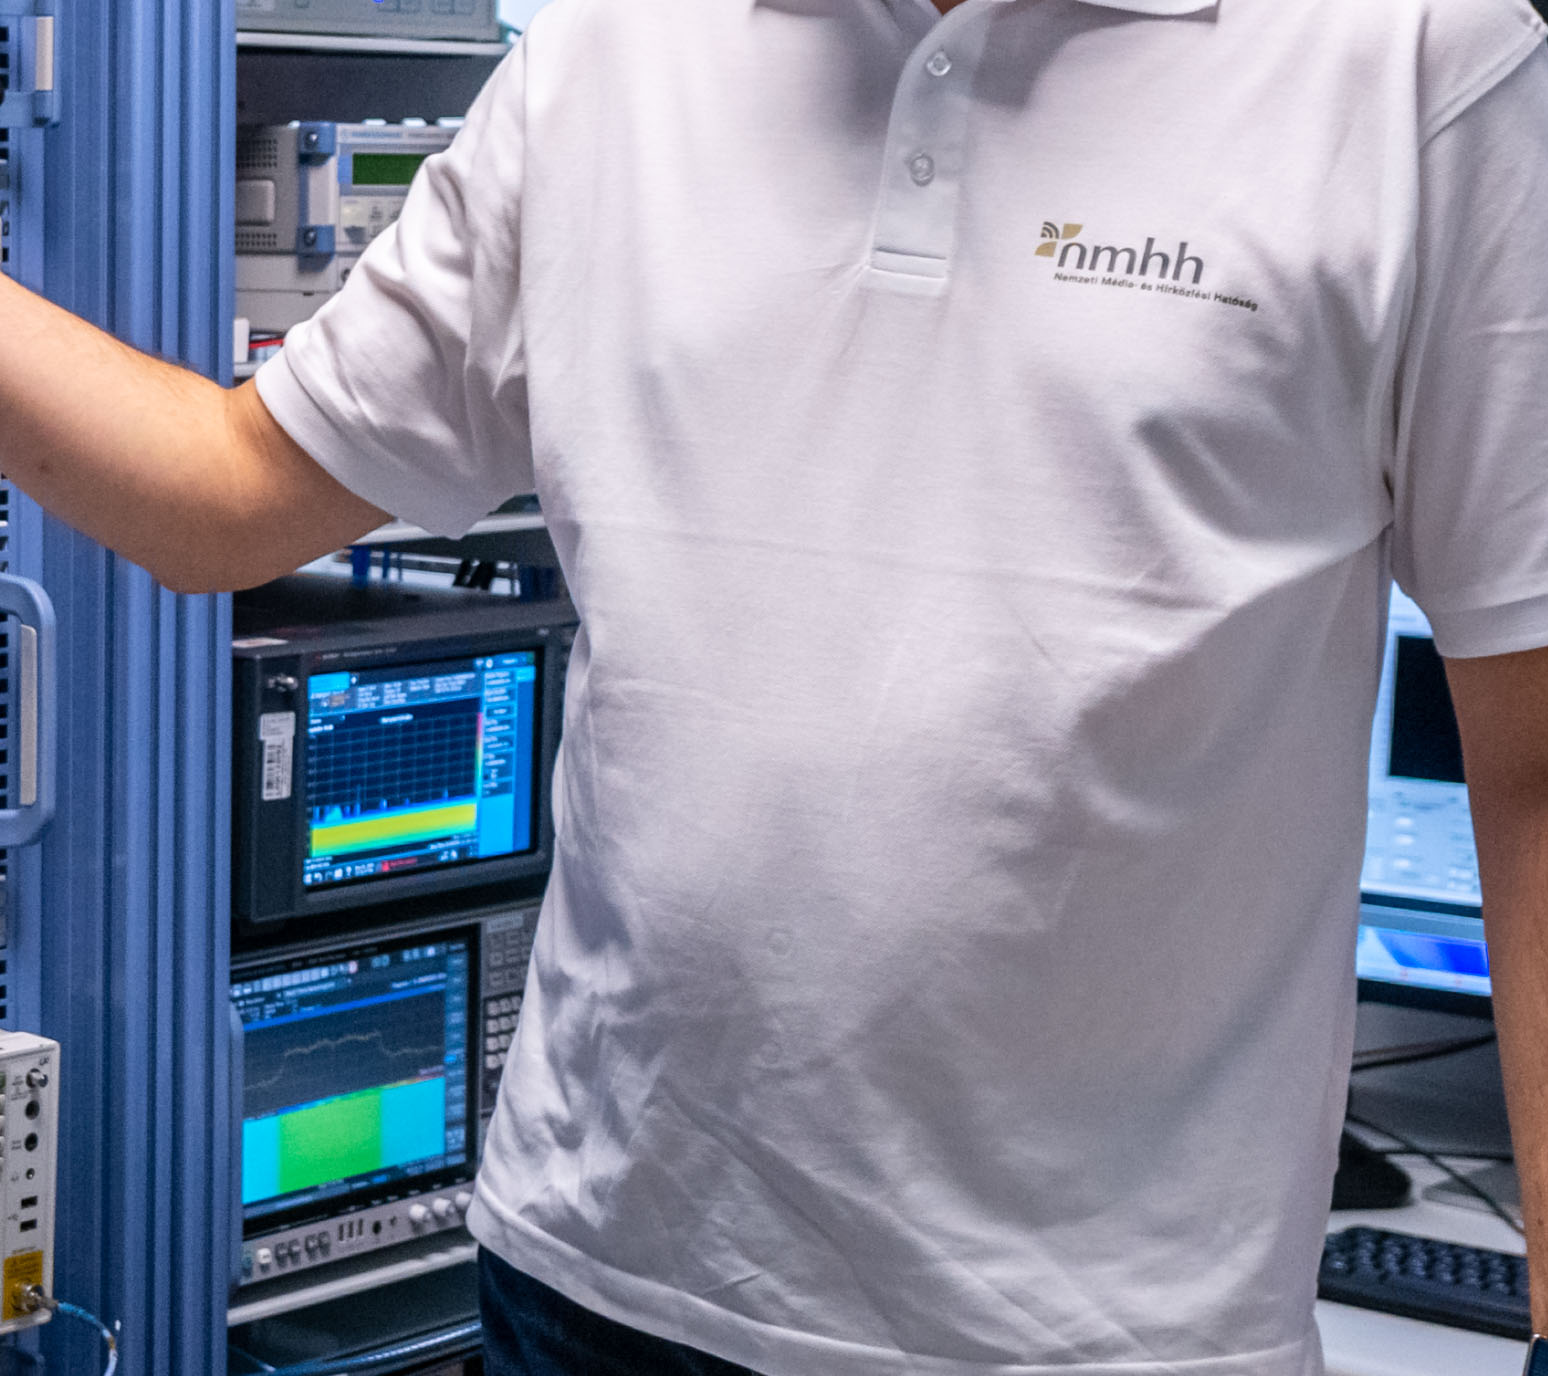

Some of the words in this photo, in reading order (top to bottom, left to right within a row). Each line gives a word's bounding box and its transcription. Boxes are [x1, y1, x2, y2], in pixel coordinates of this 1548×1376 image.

[1057, 237, 1204, 284] nmhh
[1054, 272, 1098, 286] Nemzeti
[1213, 292, 1258, 312] Hatóság
